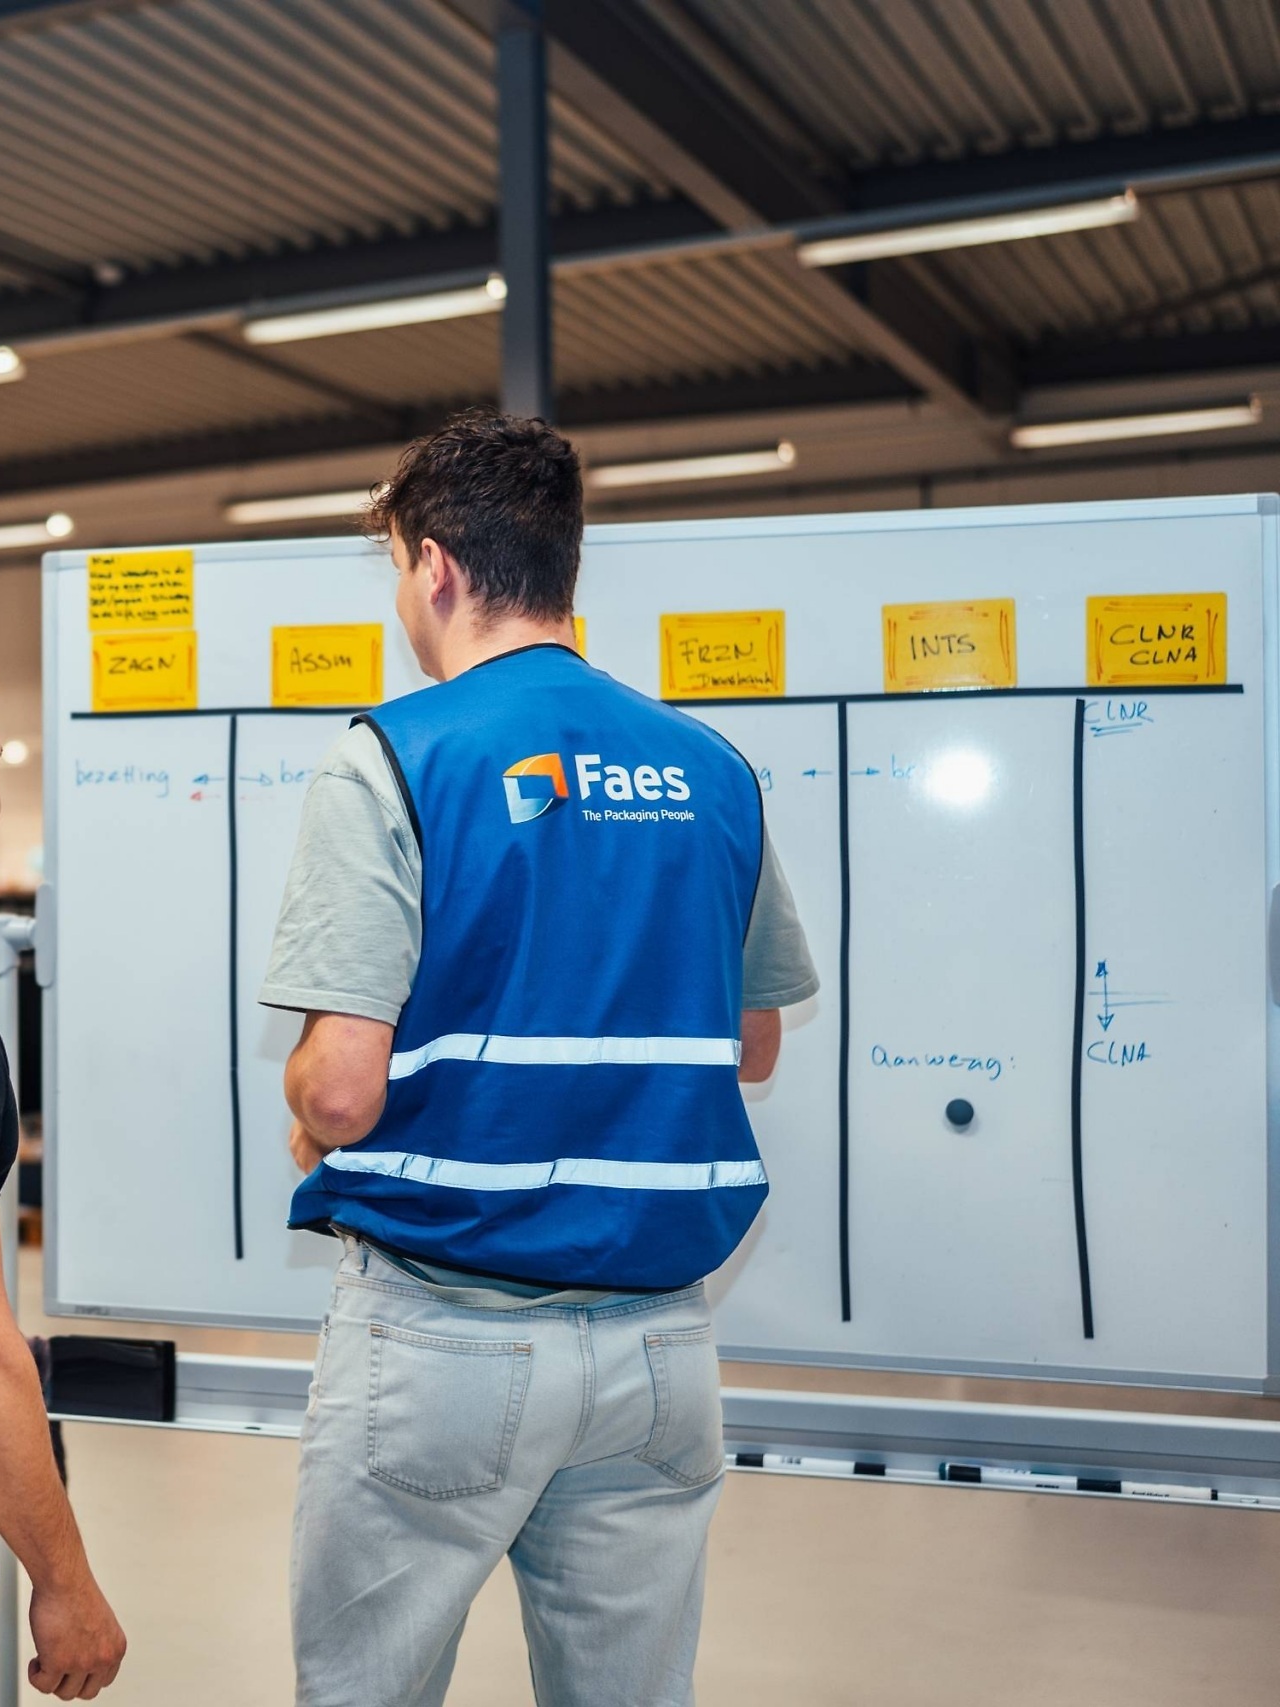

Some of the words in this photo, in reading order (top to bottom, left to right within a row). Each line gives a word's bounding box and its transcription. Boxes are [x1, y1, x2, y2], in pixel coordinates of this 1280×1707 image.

[911, 633, 977, 661] INTS
[1110, 623, 1195, 646] CLNR
[1129, 651, 1197, 666] CLNA
[75, 760, 170, 798] bezetting
[574, 754, 691, 801] Faes
[582, 810, 602, 822] The
[604, 809, 659, 823] Packaging
[661, 809, 695, 821] People
[1086, 1041, 1152, 1067] CLNA
